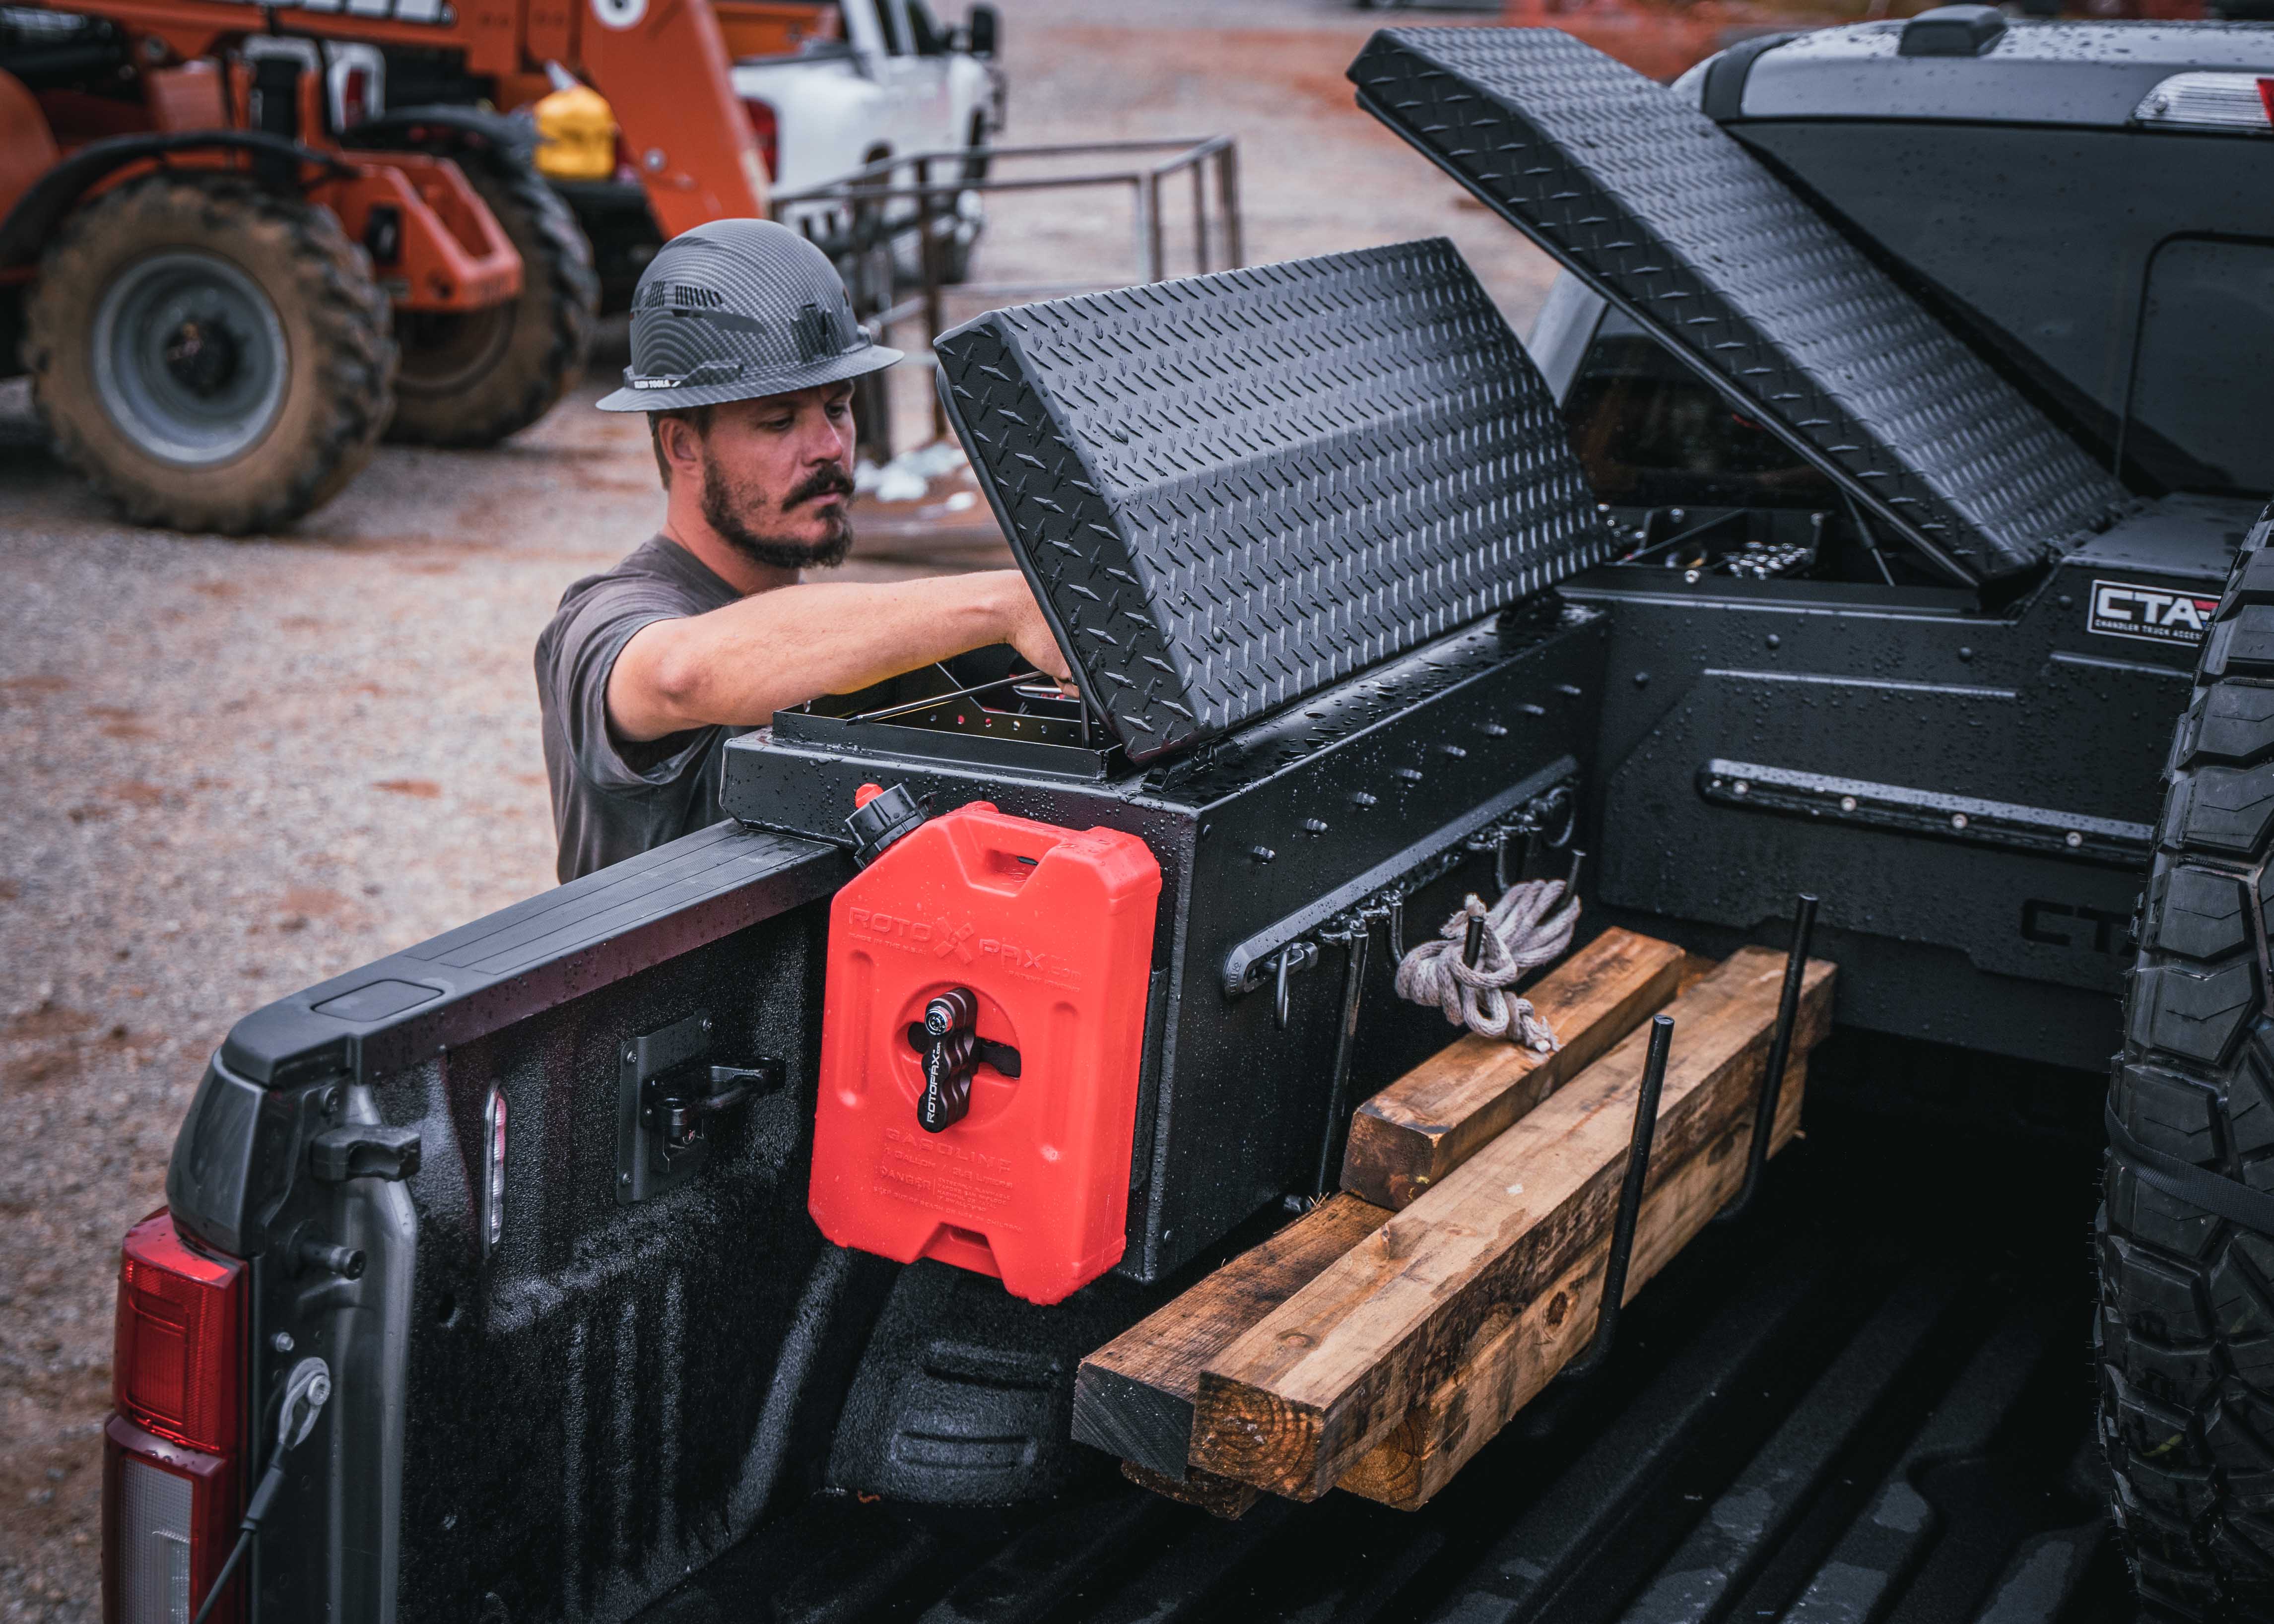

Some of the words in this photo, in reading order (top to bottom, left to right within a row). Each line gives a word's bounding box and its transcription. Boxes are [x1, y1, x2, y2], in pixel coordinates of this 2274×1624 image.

[649, 379, 670, 389] TOOLS
[2094, 618, 2140, 632] CHANDLER
[2140, 625, 2169, 636] TRUCK
[2097, 587, 2204, 631] CTA
[849, 906, 933, 942] ROTO
[884, 940, 901, 950] THE
[886, 1127, 1012, 1173] GASOLINE
[894, 1150, 937, 1169] GALLON
[976, 1172, 1013, 1190] LITERS
